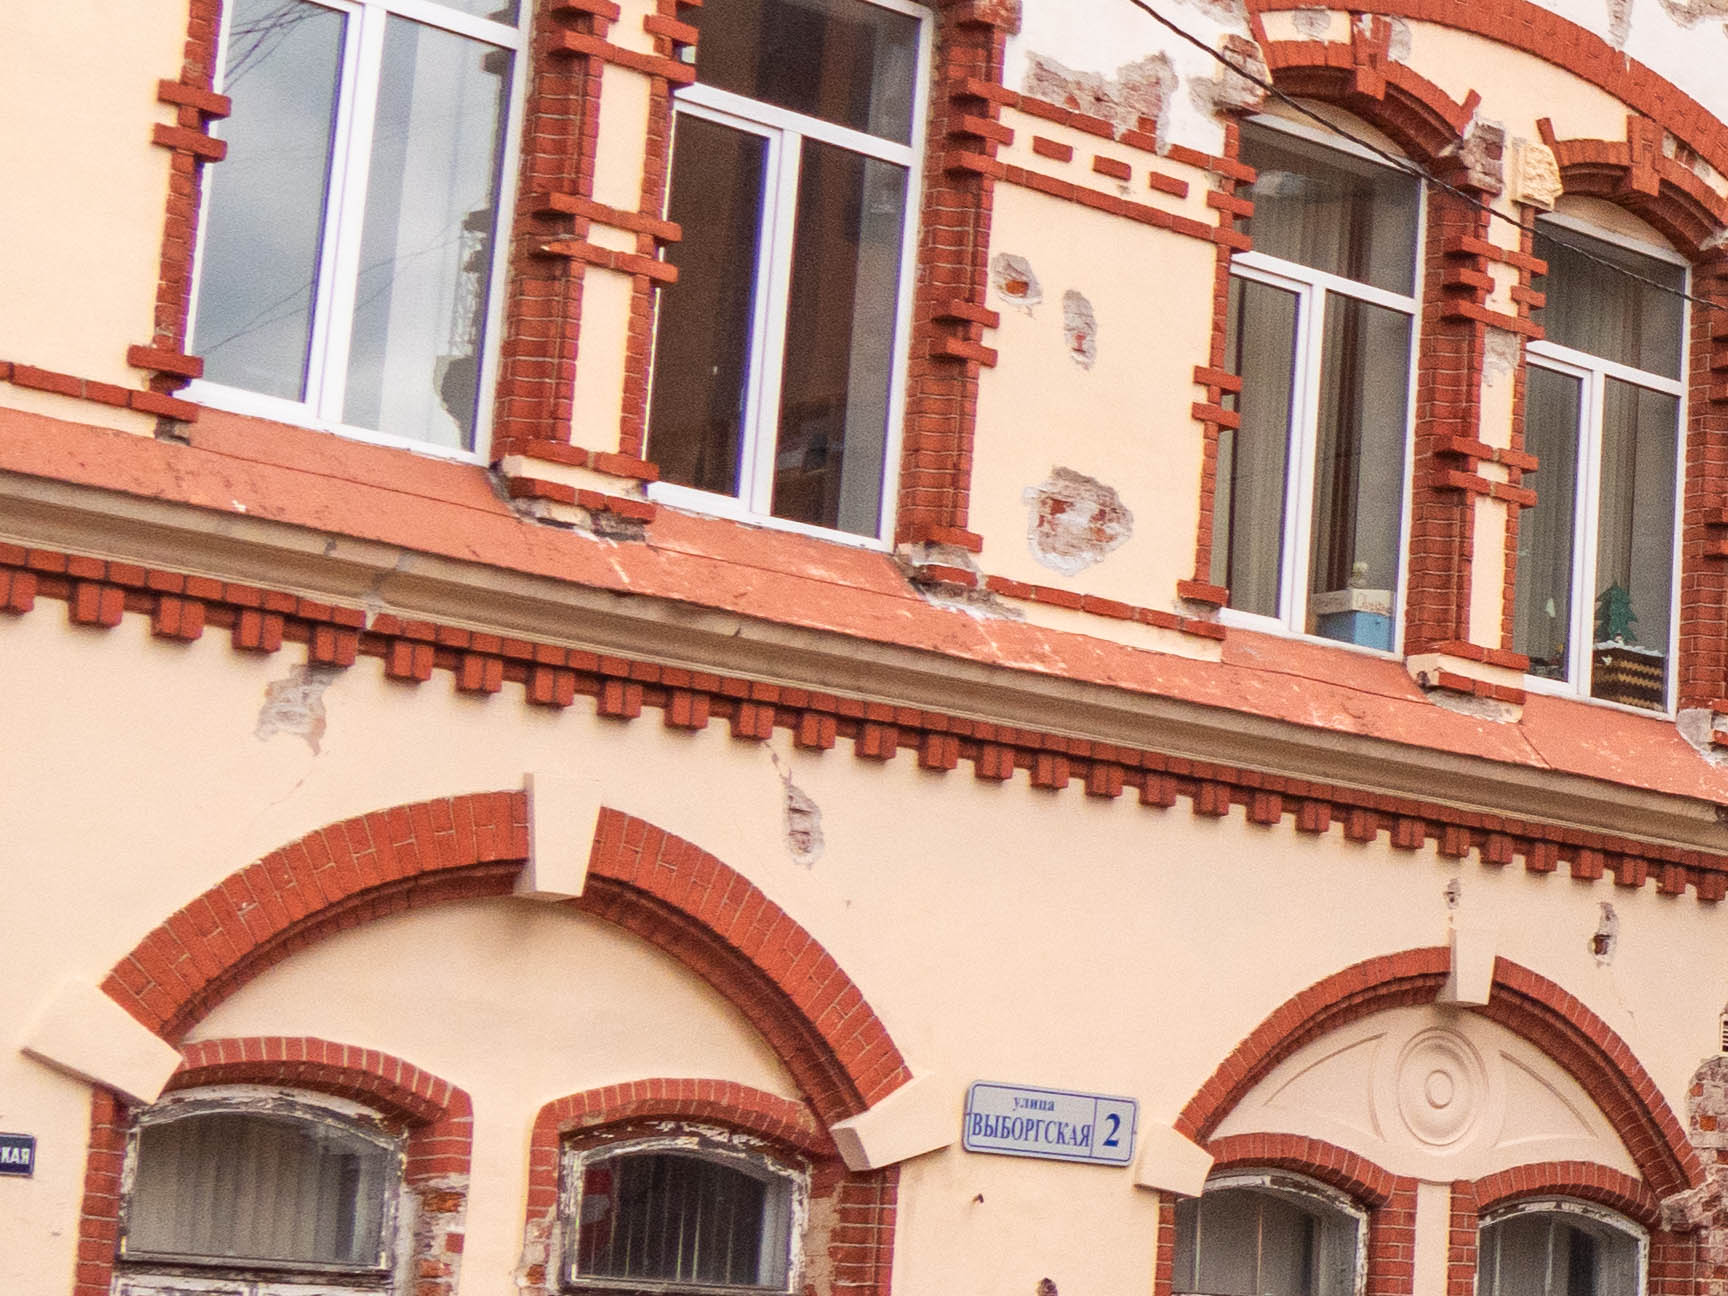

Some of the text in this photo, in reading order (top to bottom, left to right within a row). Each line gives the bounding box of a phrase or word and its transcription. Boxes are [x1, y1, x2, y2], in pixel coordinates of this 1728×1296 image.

[1012, 1095, 1056, 1112] улица
[971, 1112, 1121, 1147] ВЫБОРГСКАЯ 2
[0, 1146, 31, 1165] КАЯ
